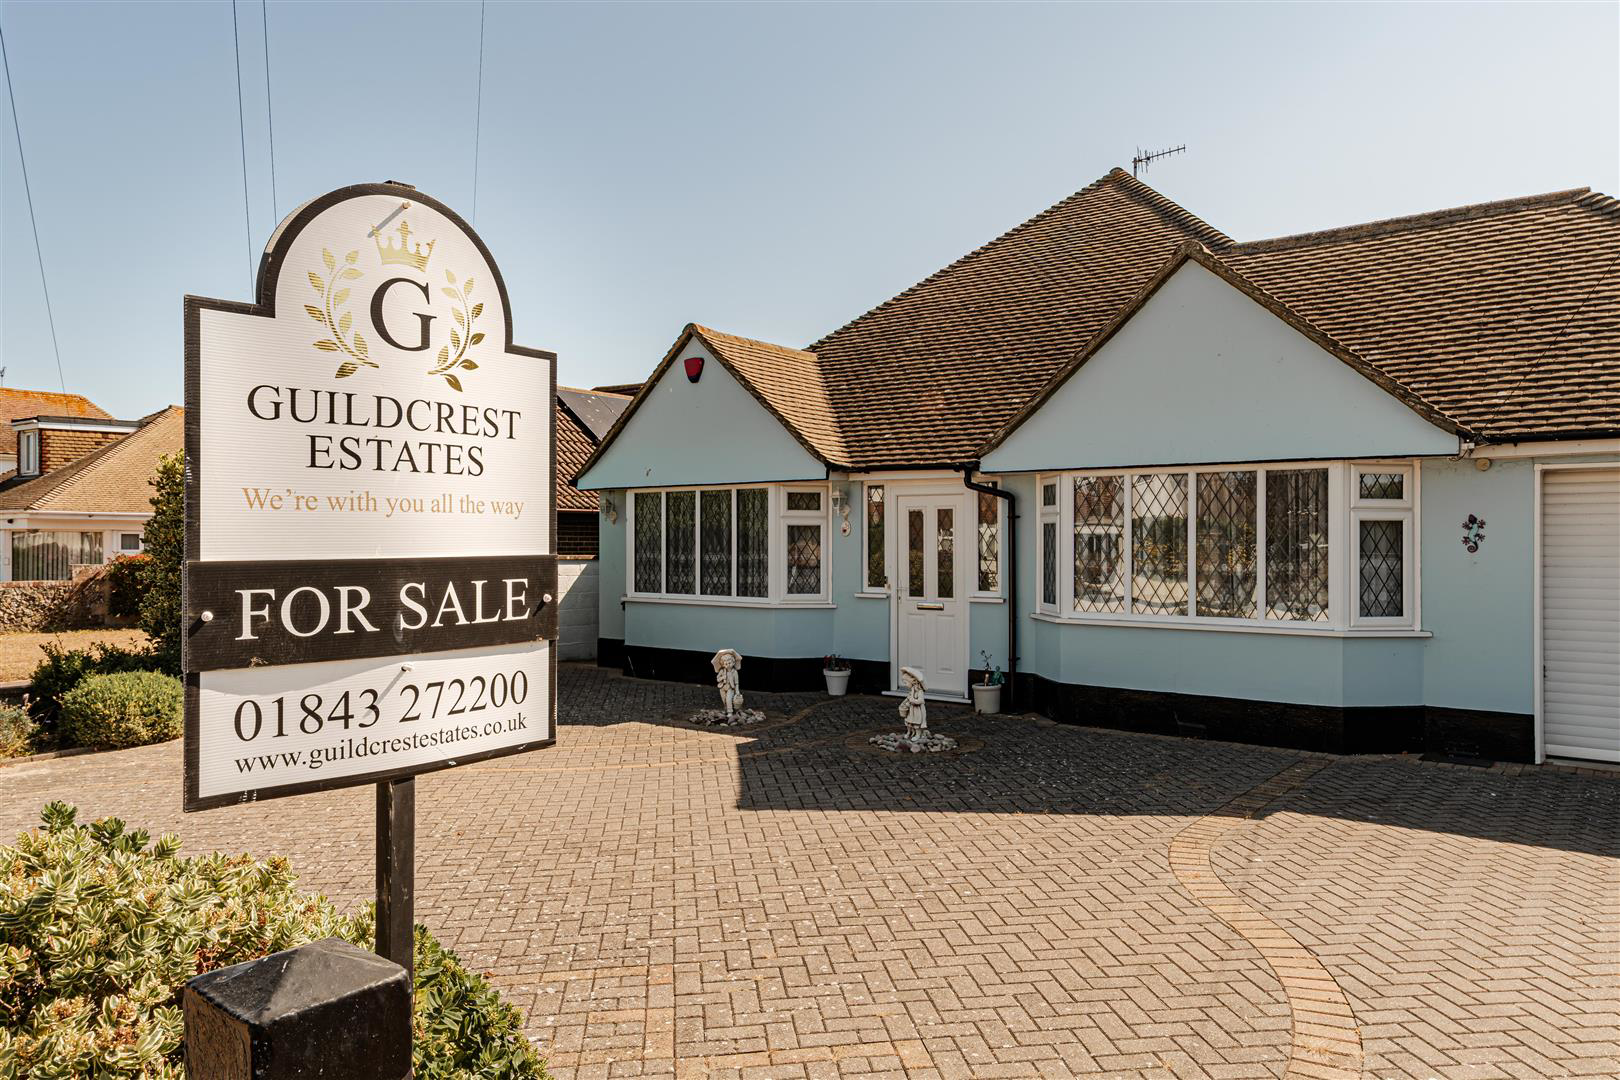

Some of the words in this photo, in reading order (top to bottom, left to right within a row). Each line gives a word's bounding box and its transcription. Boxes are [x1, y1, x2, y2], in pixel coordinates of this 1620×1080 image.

[369, 277, 437, 352] G
[246, 384, 522, 440] GUILDCREST
[305, 434, 484, 477] ESTATES
[327, 490, 379, 513] with
[385, 500, 425, 518] you
[431, 494, 454, 514] all
[459, 495, 485, 514] the
[490, 500, 525, 520] way
[234, 586, 380, 641] FOR
[399, 578, 531, 631] SALE
[234, 688, 381, 742] 01843
[399, 670, 528, 723] 272200
[234, 712, 528, 774] www.guildcrestestates.co.uk
